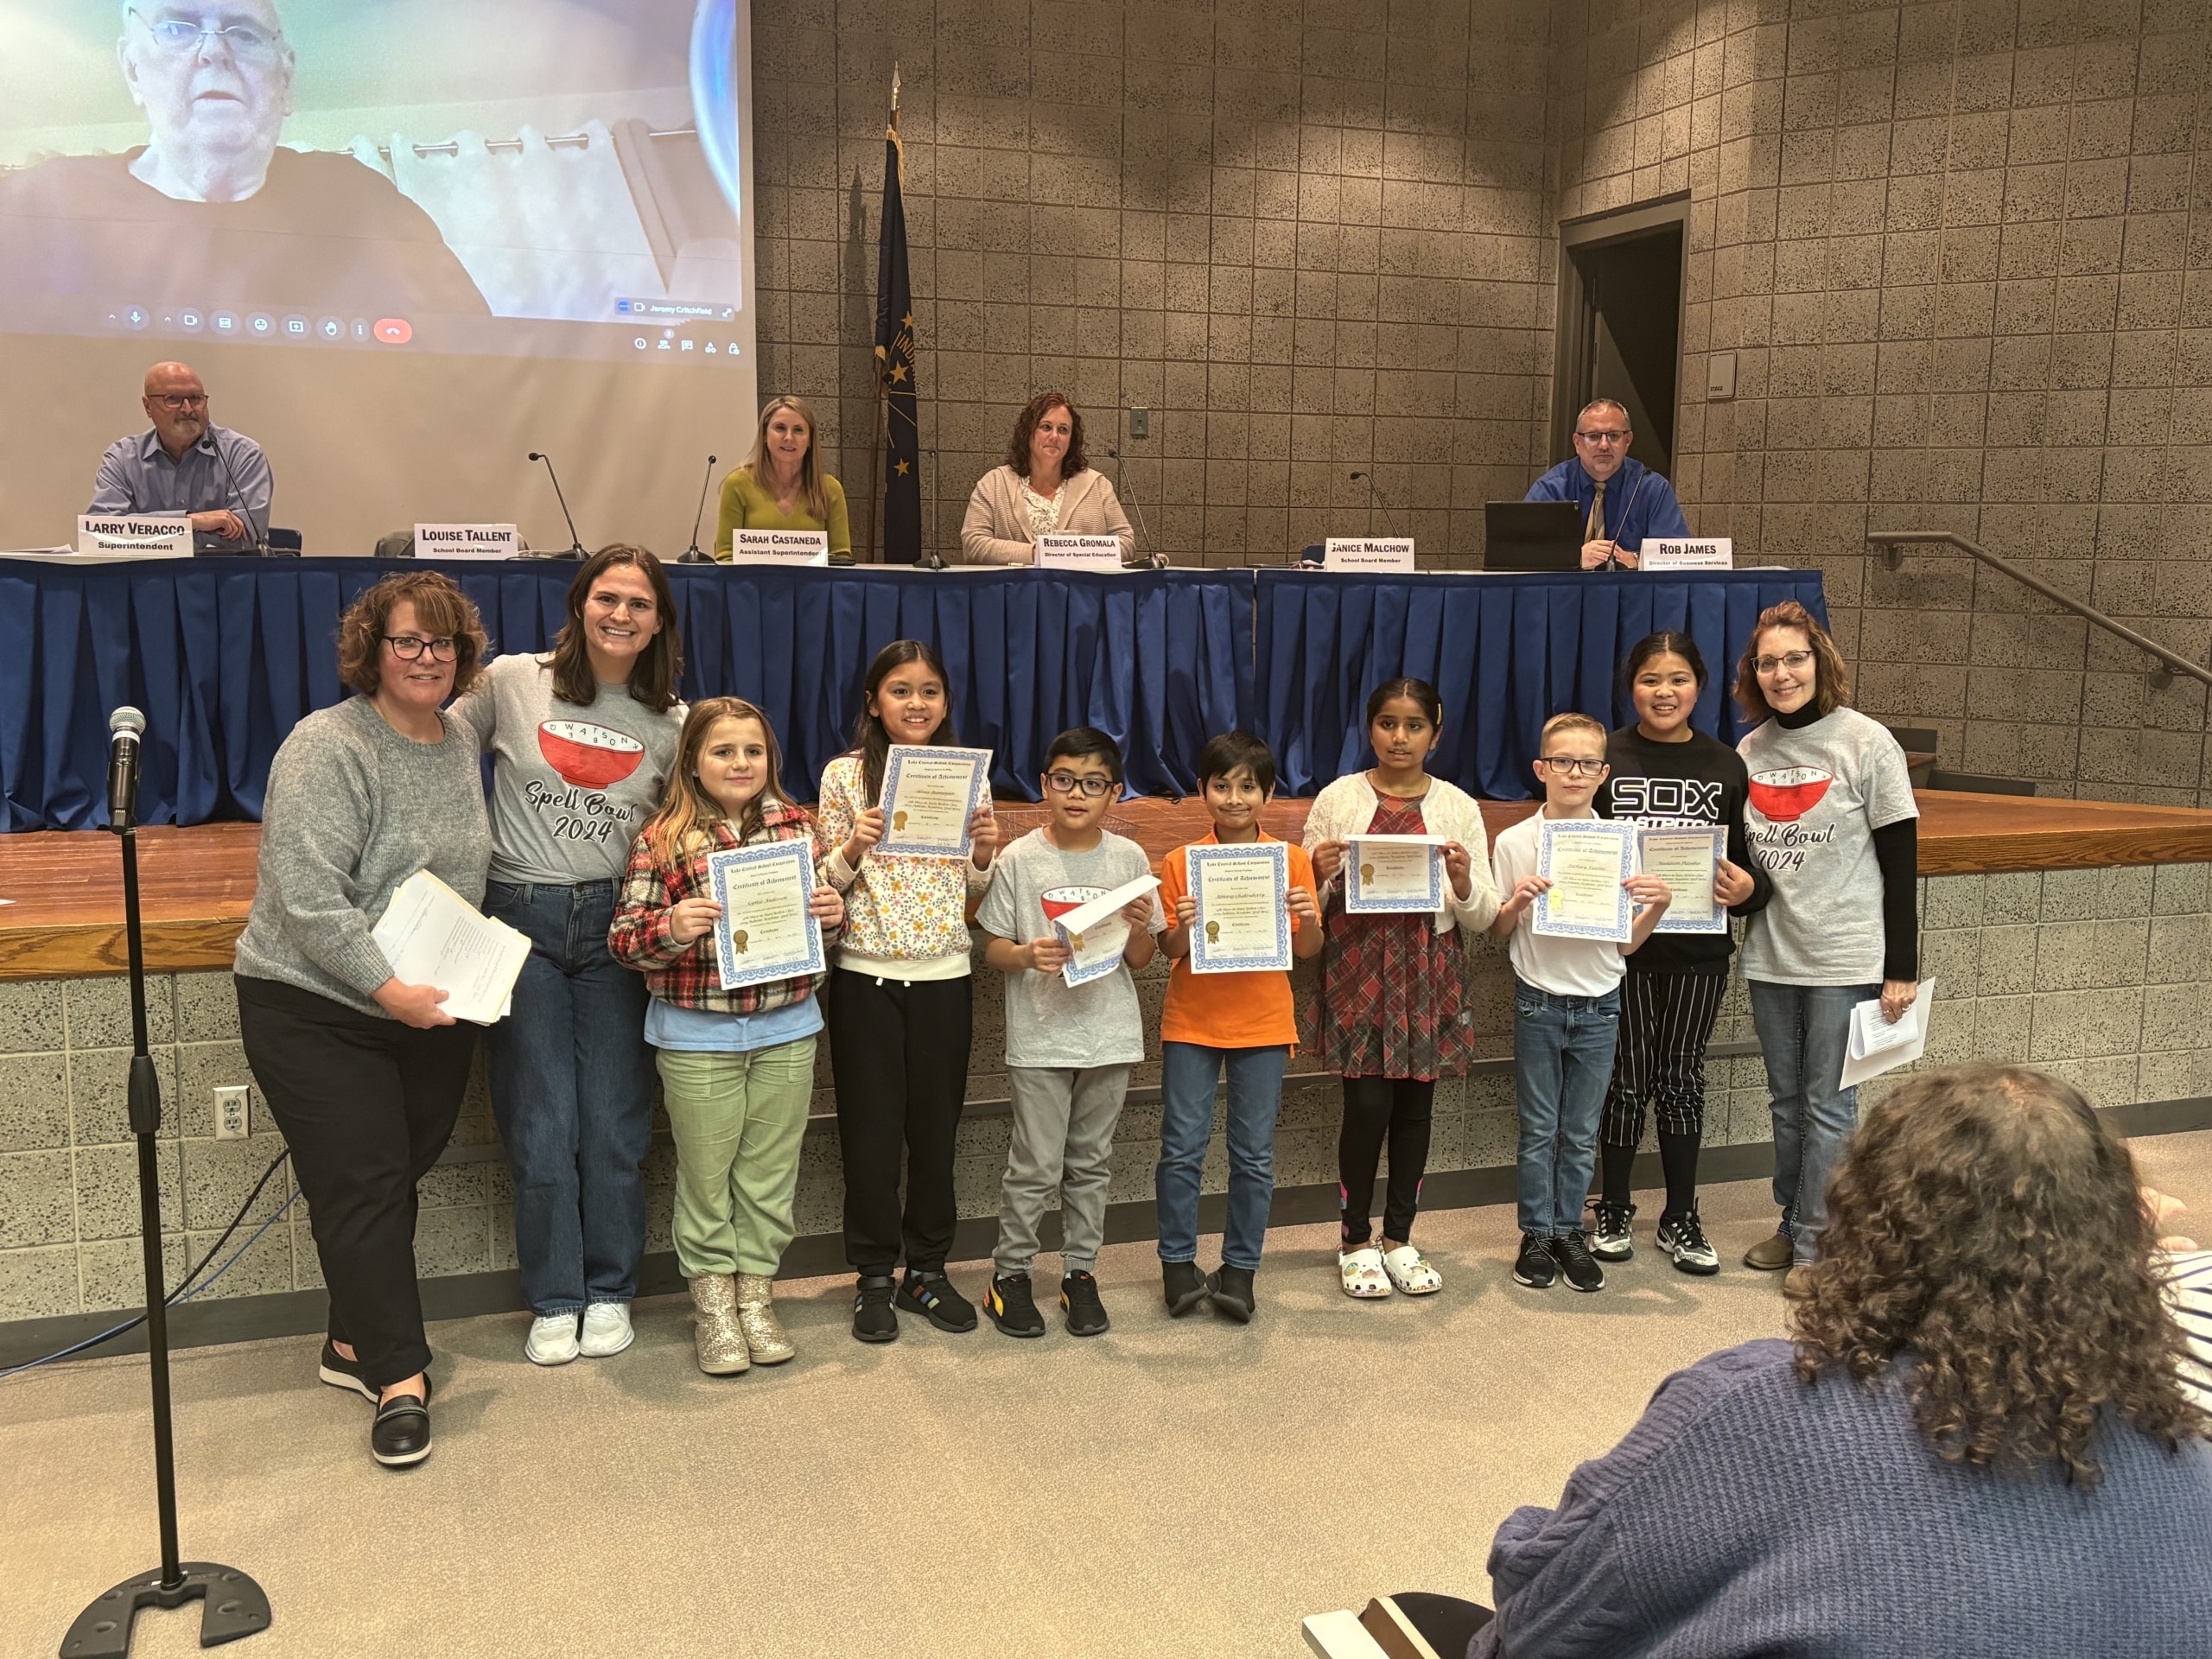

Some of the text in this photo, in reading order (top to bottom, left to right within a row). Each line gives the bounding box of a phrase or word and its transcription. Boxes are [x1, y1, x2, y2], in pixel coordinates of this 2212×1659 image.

[650, 305, 675, 314] Jeremy
[86, 521, 185, 536] LARRY VERACCO
[422, 529, 512, 541] LOUISE TALLENT
[740, 534, 821, 545] SARAH CASTANEDA
[98, 542, 173, 550] Superintendent
[1043, 538, 1116, 547] REBECCA GROMALA
[1332, 543, 1409, 553] JANICE MALCHOW
[1659, 543, 1716, 554] ROB JAMES
[525, 781, 638, 822] Spell Bowl
[1611, 777, 1723, 820] SOX
[553, 816, 613, 843] 2024
[1782, 823, 1837, 847] Bowl
[1758, 850, 1805, 871] 2024
